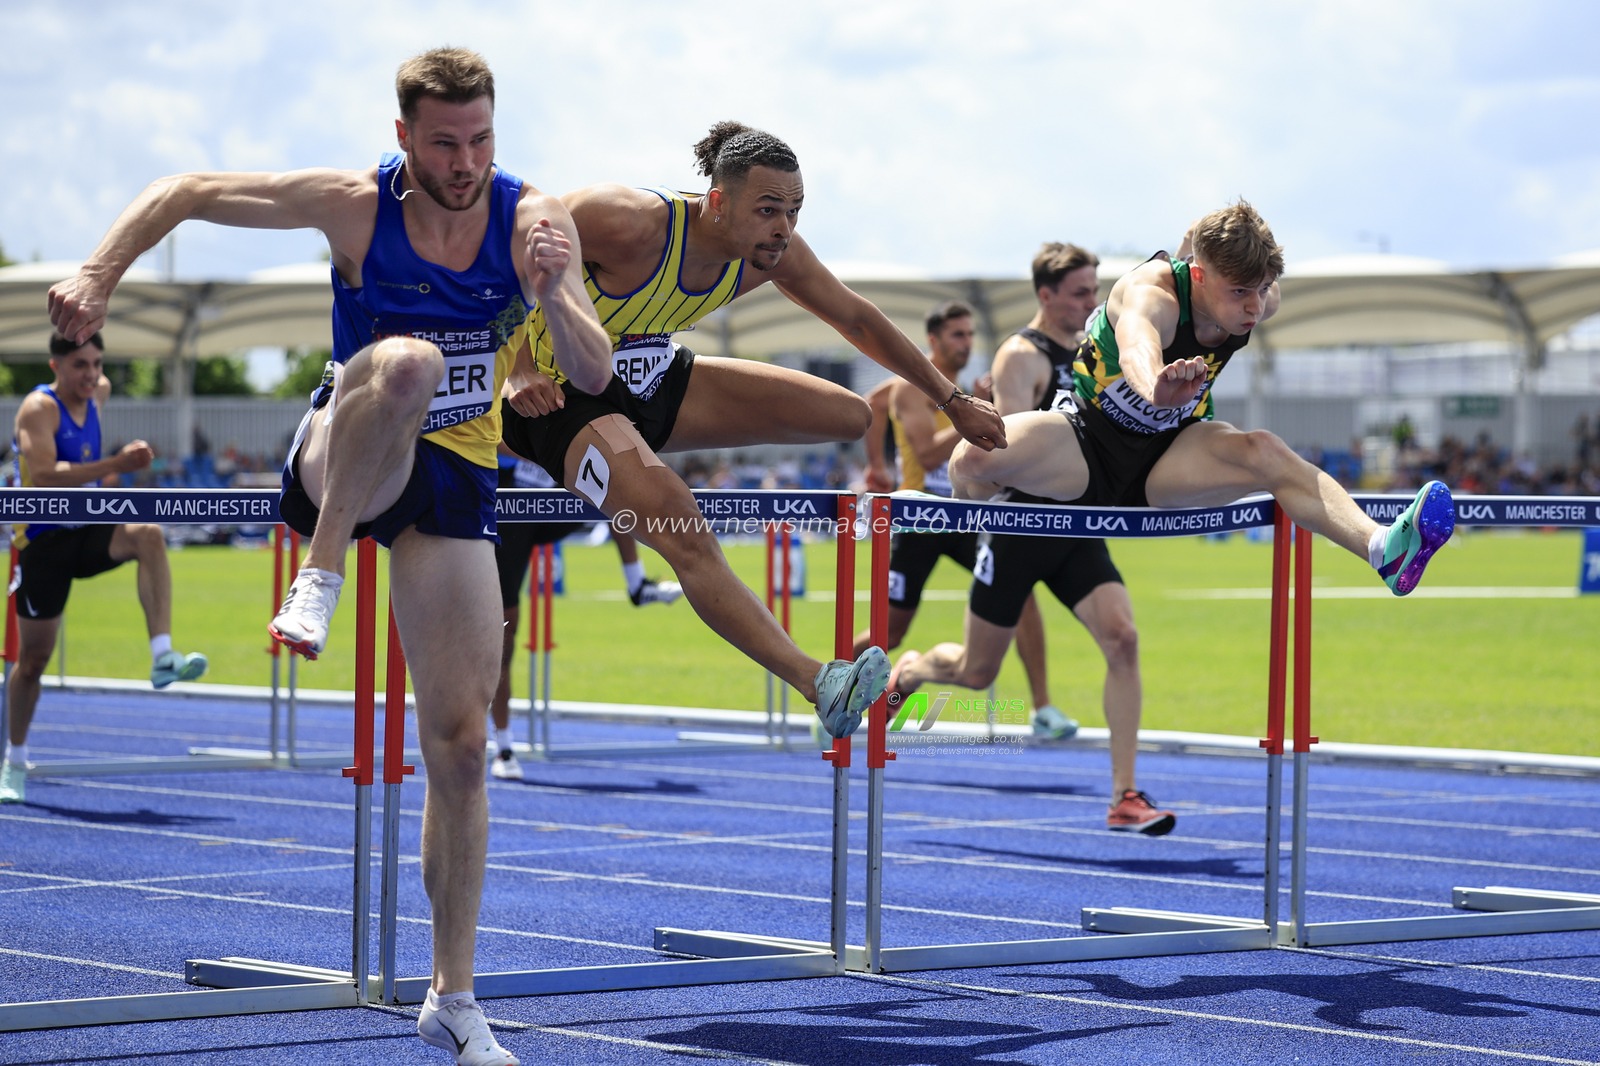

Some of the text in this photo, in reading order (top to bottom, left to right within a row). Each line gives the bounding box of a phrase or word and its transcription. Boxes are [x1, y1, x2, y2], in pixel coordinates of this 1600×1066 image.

[407, 330, 490, 342] THLETICS
[437, 340, 490, 352] NSHIPS
[582, 458, 604, 490] 7
[0, 498, 271, 516] HESTER UKA MANCHESTER
[494, 498, 584, 514] ANCHESTER
[773, 499, 817, 515] UKA
[1459, 505, 1495, 519] UKA
[1506, 505, 1586, 519] MANCHESTER
[903, 505, 1262, 532] UKA MANCHESTER UKA MANCHESTER UKA
